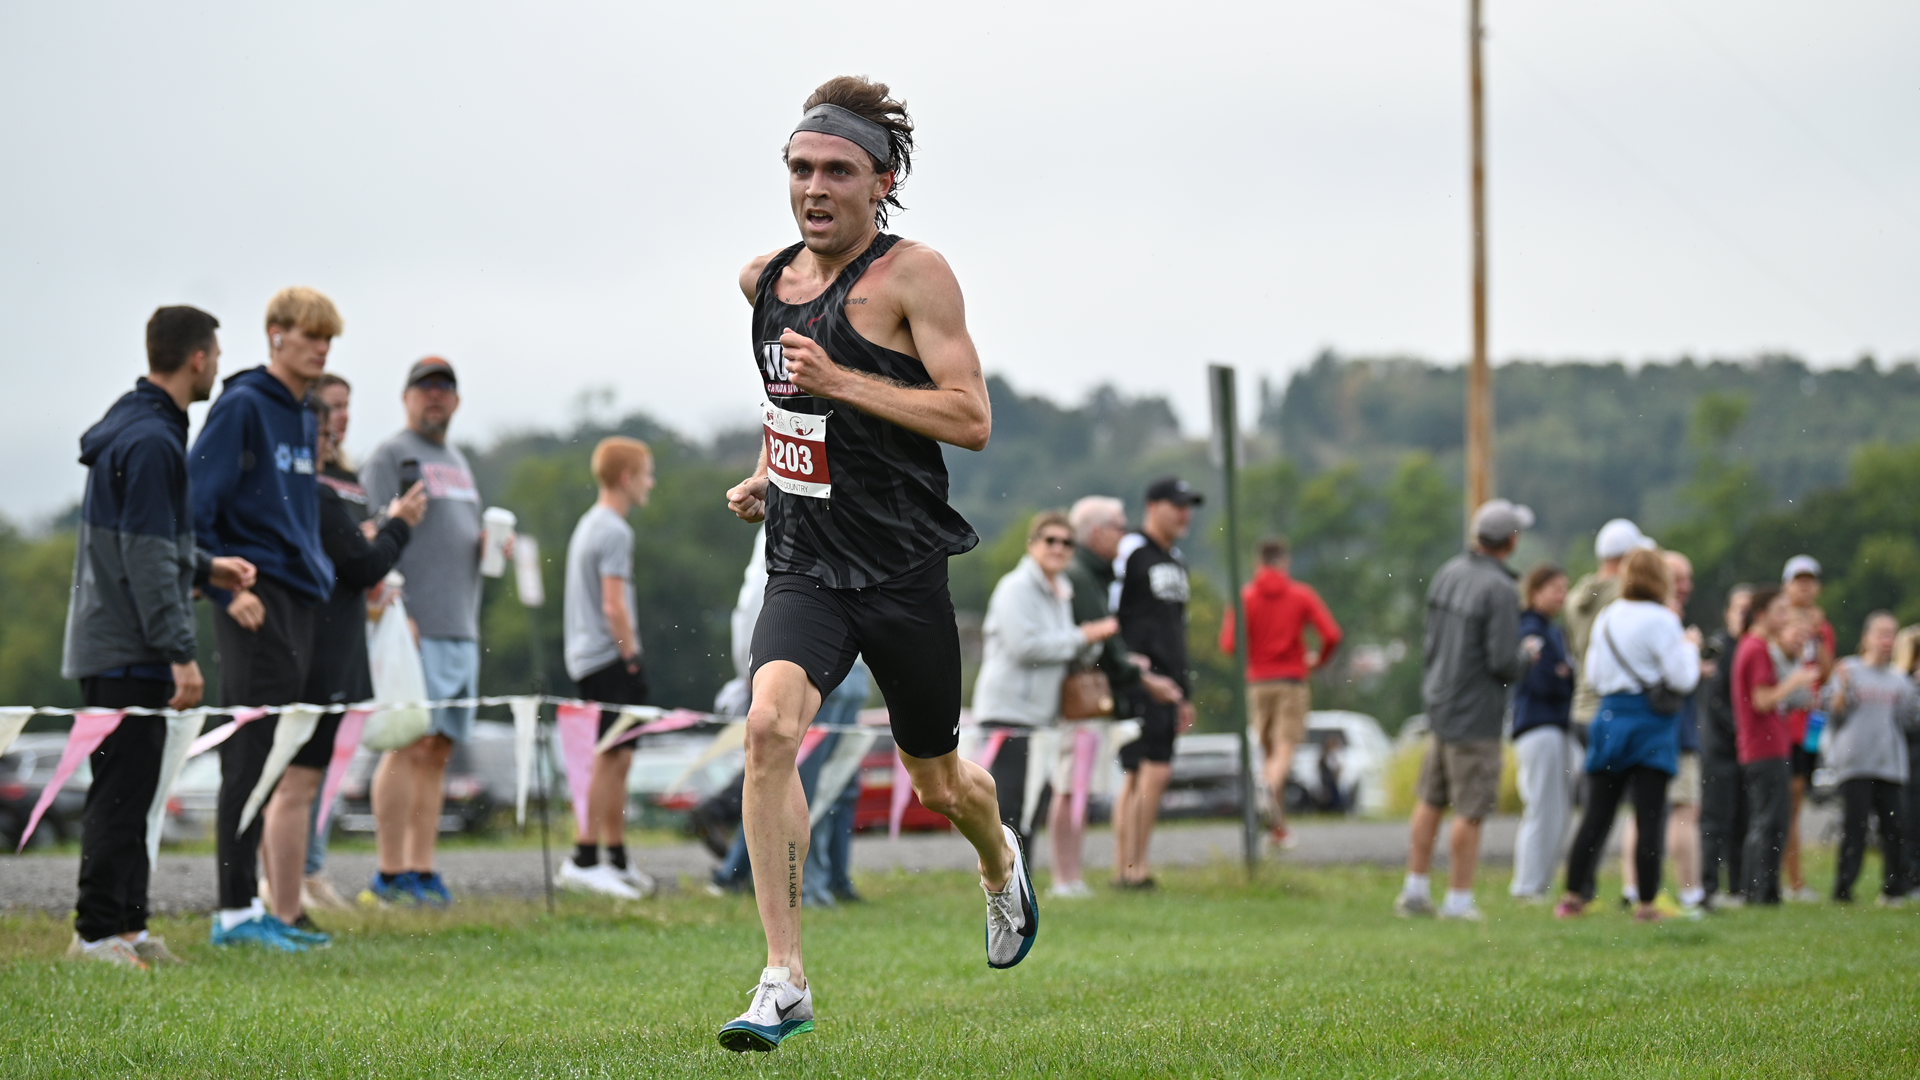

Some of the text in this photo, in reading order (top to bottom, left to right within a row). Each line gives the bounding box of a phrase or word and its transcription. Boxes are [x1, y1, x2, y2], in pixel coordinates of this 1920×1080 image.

[769, 434, 814, 475] 3203
[783, 481, 809, 493] COUNTRY
[788, 841, 797, 908] ENJOY THE RIDE
